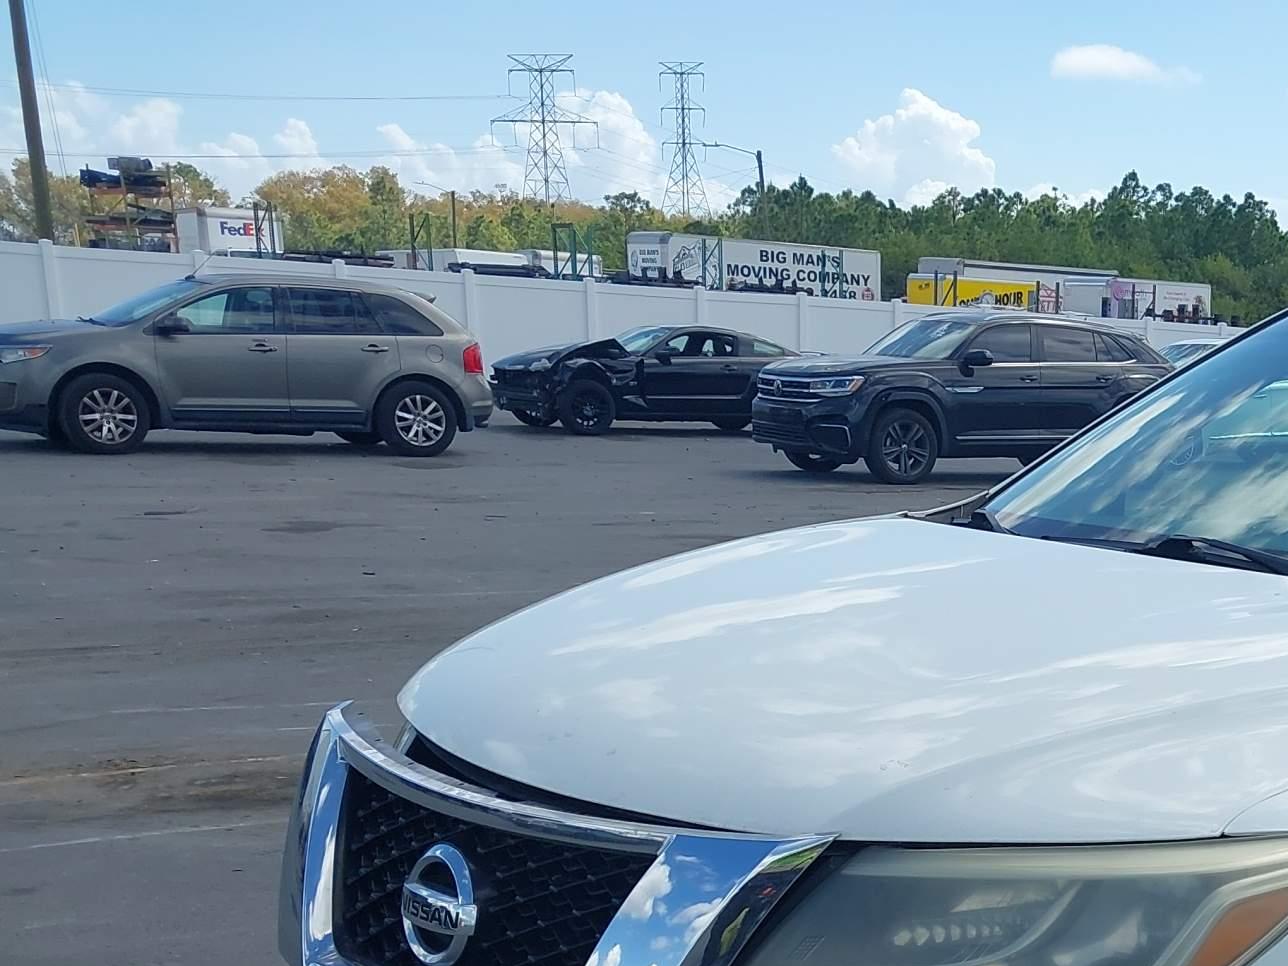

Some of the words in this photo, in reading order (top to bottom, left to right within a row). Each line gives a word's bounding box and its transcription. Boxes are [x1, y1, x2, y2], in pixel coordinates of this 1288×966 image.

[760, 250, 787, 264] BIG
[792, 253, 841, 268] MAN'S
[727, 264, 791, 281] MOVING
[796, 269, 871, 287] COMPANY
[995, 291, 1024, 306] HOUR
[403, 892, 460, 929] NISSAN
